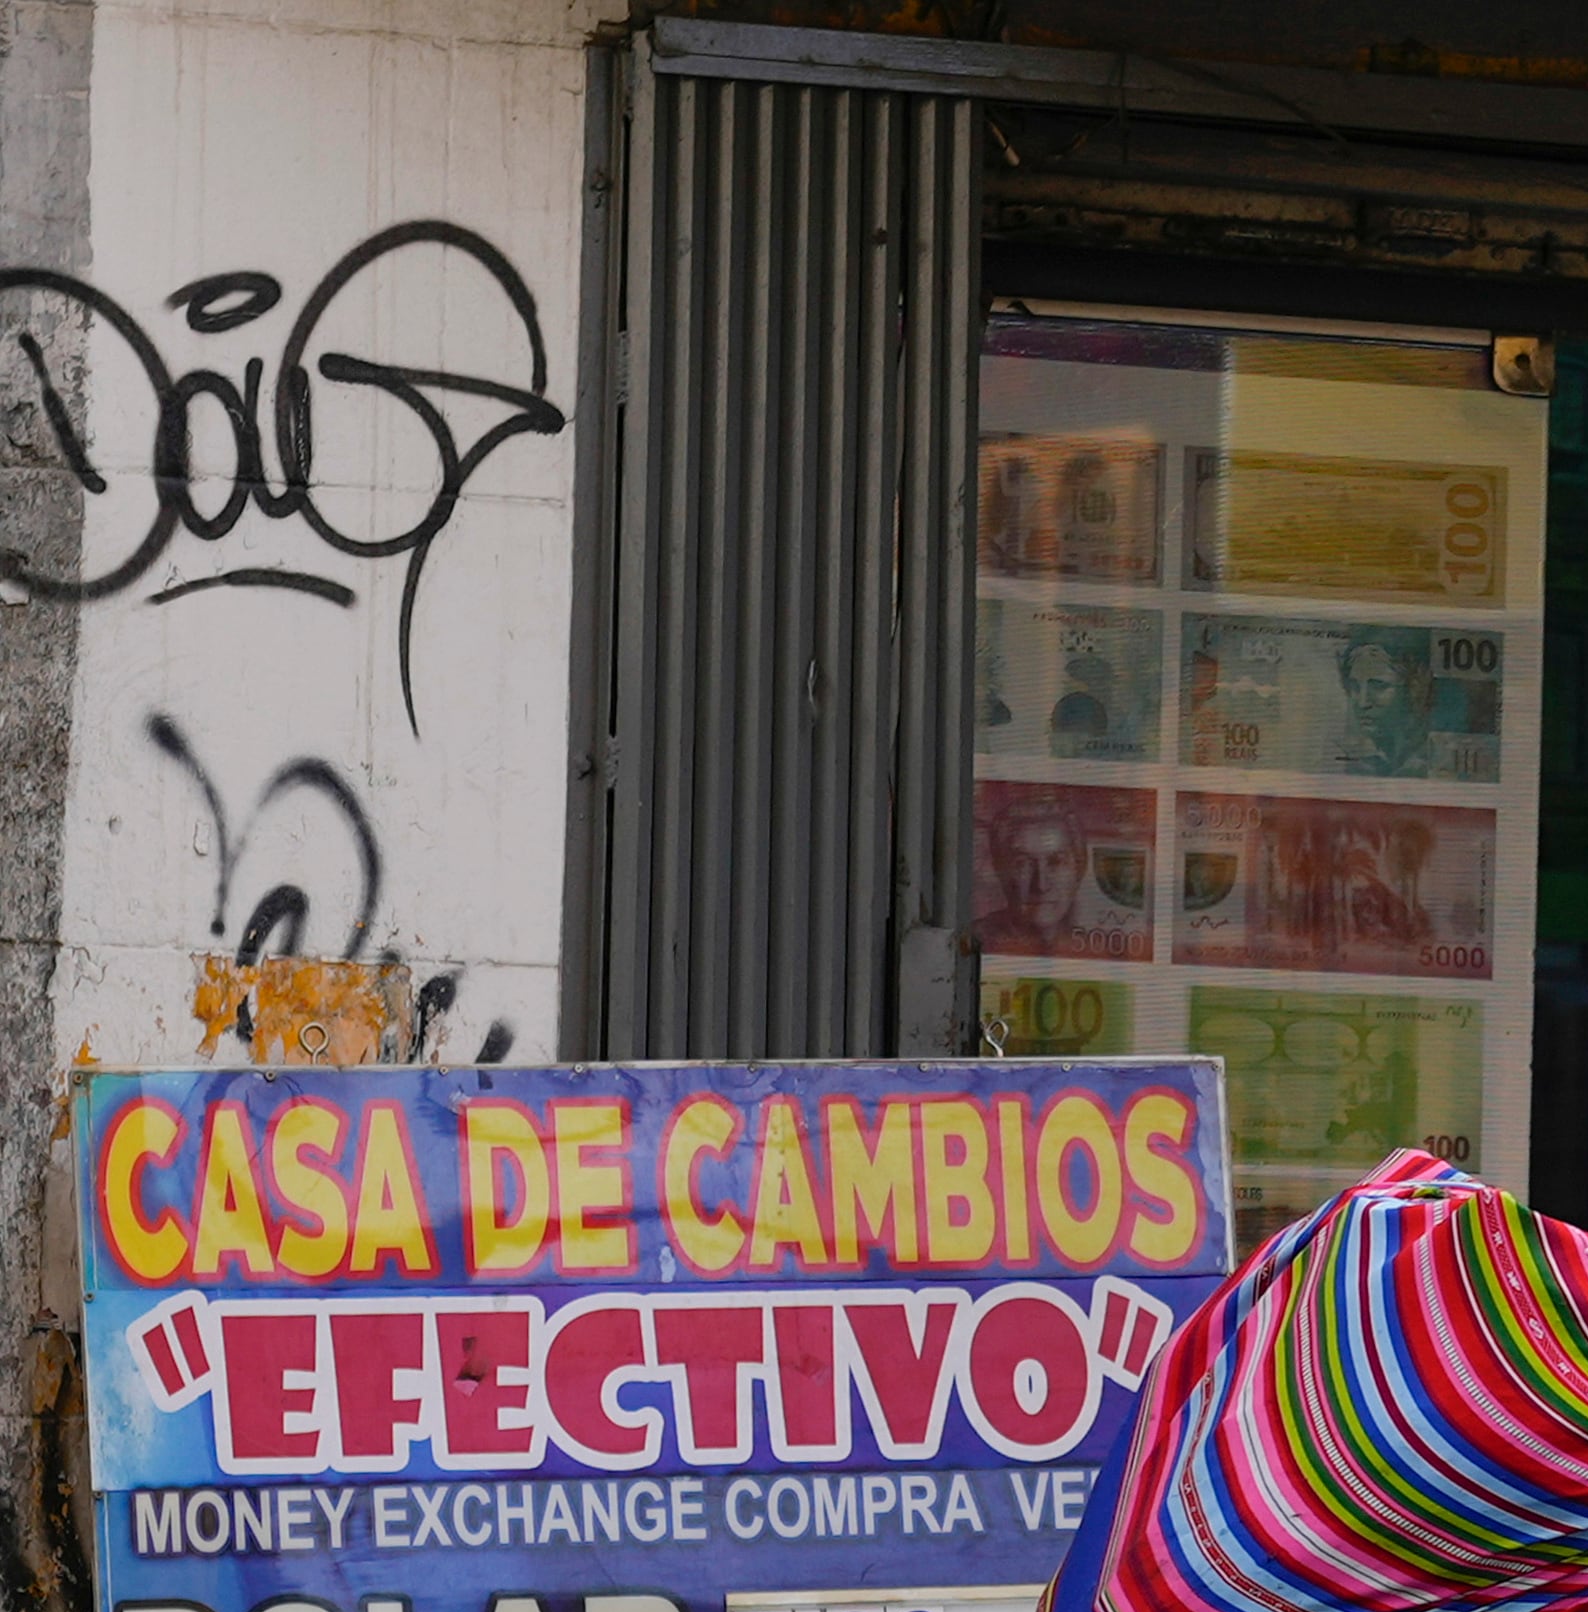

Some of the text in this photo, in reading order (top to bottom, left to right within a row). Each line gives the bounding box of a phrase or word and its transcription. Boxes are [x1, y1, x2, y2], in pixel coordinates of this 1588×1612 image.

[1446, 482, 1490, 585] 100
[1438, 637, 1497, 675] 100
[1070, 926, 1145, 956] 5000
[1418, 945, 1486, 969] 5000
[1423, 1135, 1471, 1162] 100
[100, 1088, 1202, 1282] CASA DE CAMBIOS
[135, 1485, 354, 1558] MONEY
[372, 1478, 708, 1549] EXCHANGE
[724, 1472, 984, 1541] COMPRA
